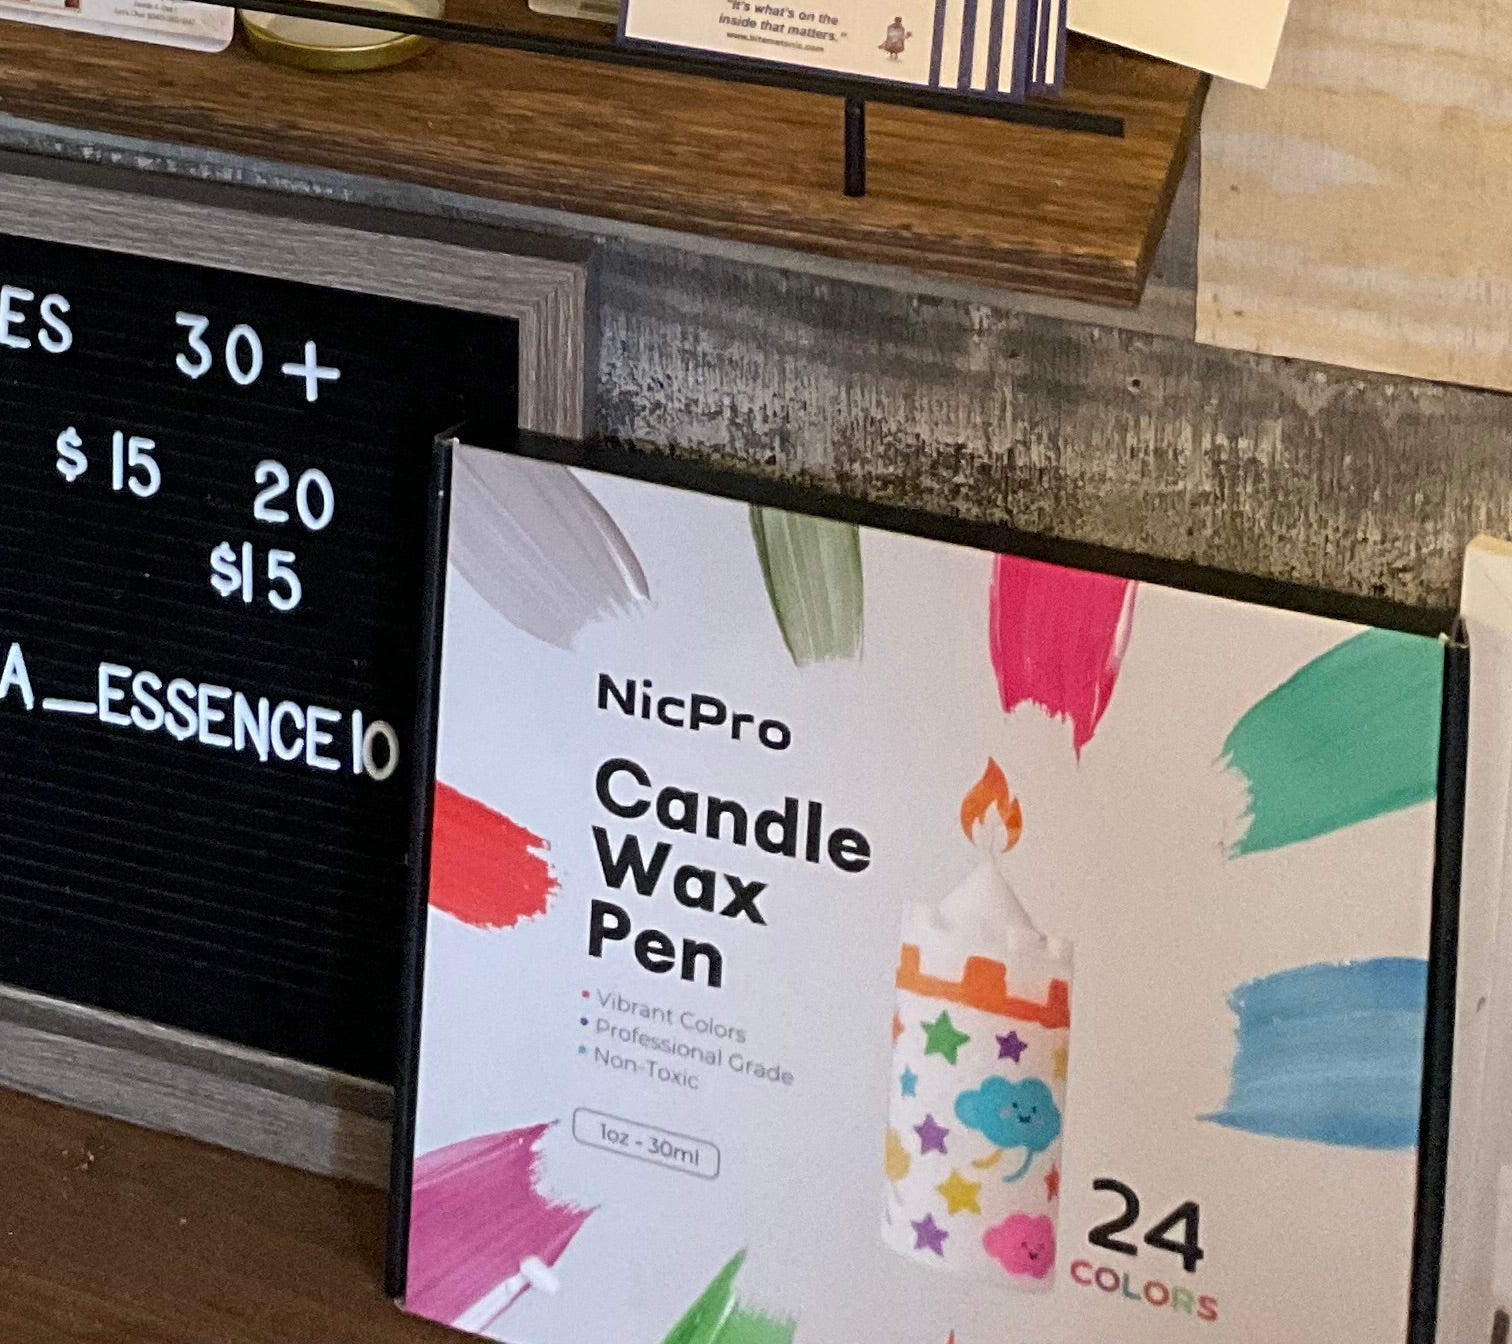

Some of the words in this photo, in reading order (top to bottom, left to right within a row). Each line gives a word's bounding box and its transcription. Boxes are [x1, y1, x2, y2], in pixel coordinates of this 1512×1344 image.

[719, 13, 757, 29] inside
[760, 19, 785, 33] that
[754, 4, 795, 18] what's
[798, 11, 815, 22] on
[818, 13, 839, 26] the
[252, 459, 335, 530] 20
[209, 540, 303, 611] $15
[596, 672, 793, 752] NicPro
[594, 757, 873, 874] Candle
[591, 824, 770, 927] Wax
[587, 898, 723, 989] Pen
[595, 1016, 724, 1068] Professional
[728, 1052, 795, 1087] Grade
[596, 990, 674, 1026] Vibrant
[680, 1011, 748, 1045] Colors
[593, 1045, 700, 1091] Non-Toxic
[648, 1136, 701, 1167] 30ml
[1087, 1177, 1205, 1274] 24
[1069, 1259, 1219, 1323] COLORS
